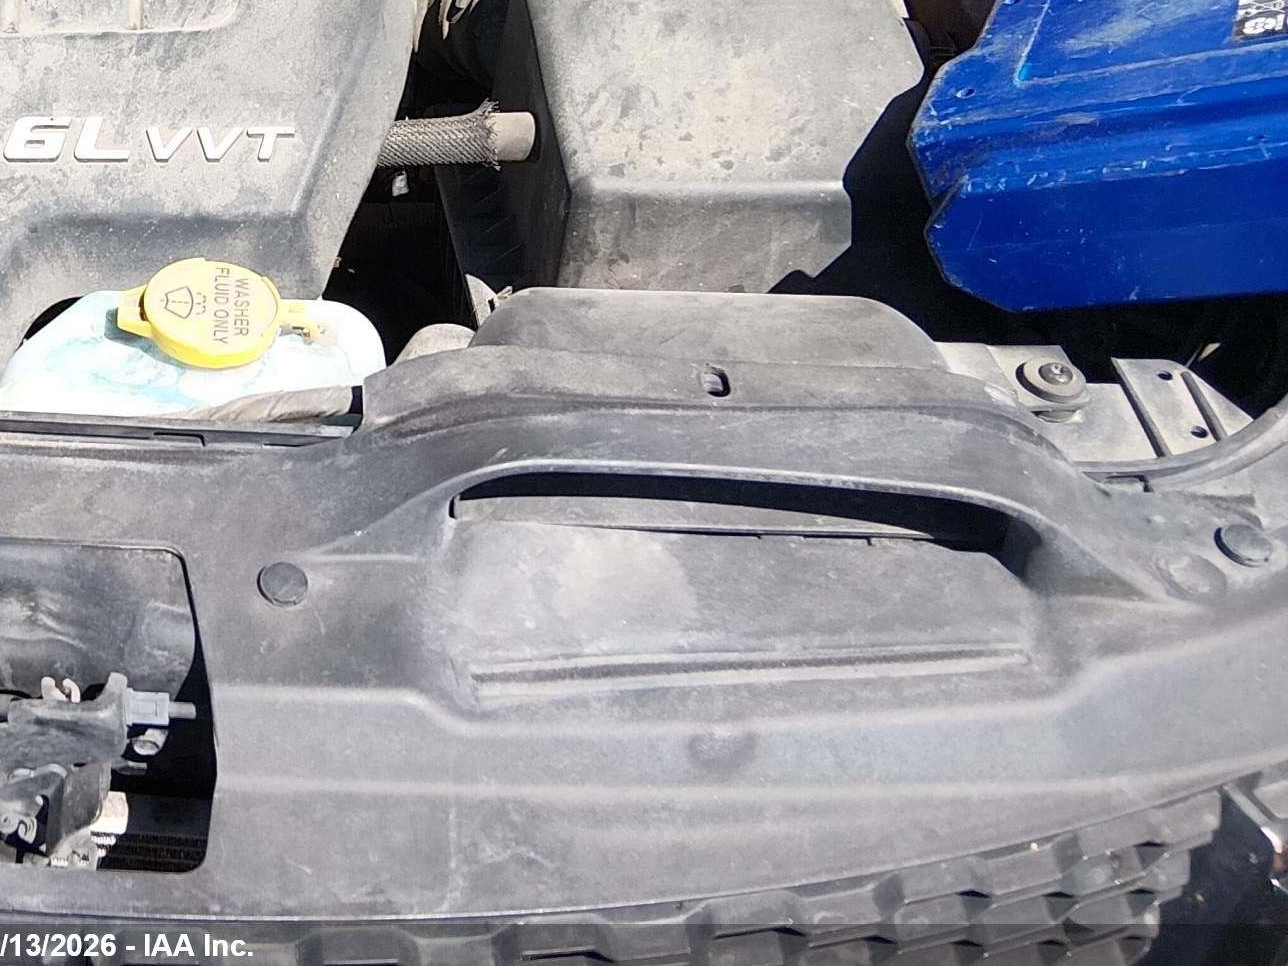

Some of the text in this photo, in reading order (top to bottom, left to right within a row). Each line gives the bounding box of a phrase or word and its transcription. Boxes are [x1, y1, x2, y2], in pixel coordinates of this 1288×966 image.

[145, 126, 296, 163] VVT
[213, 267, 230, 345] FLUID ONLY
[233, 278, 250, 337] WASHER
